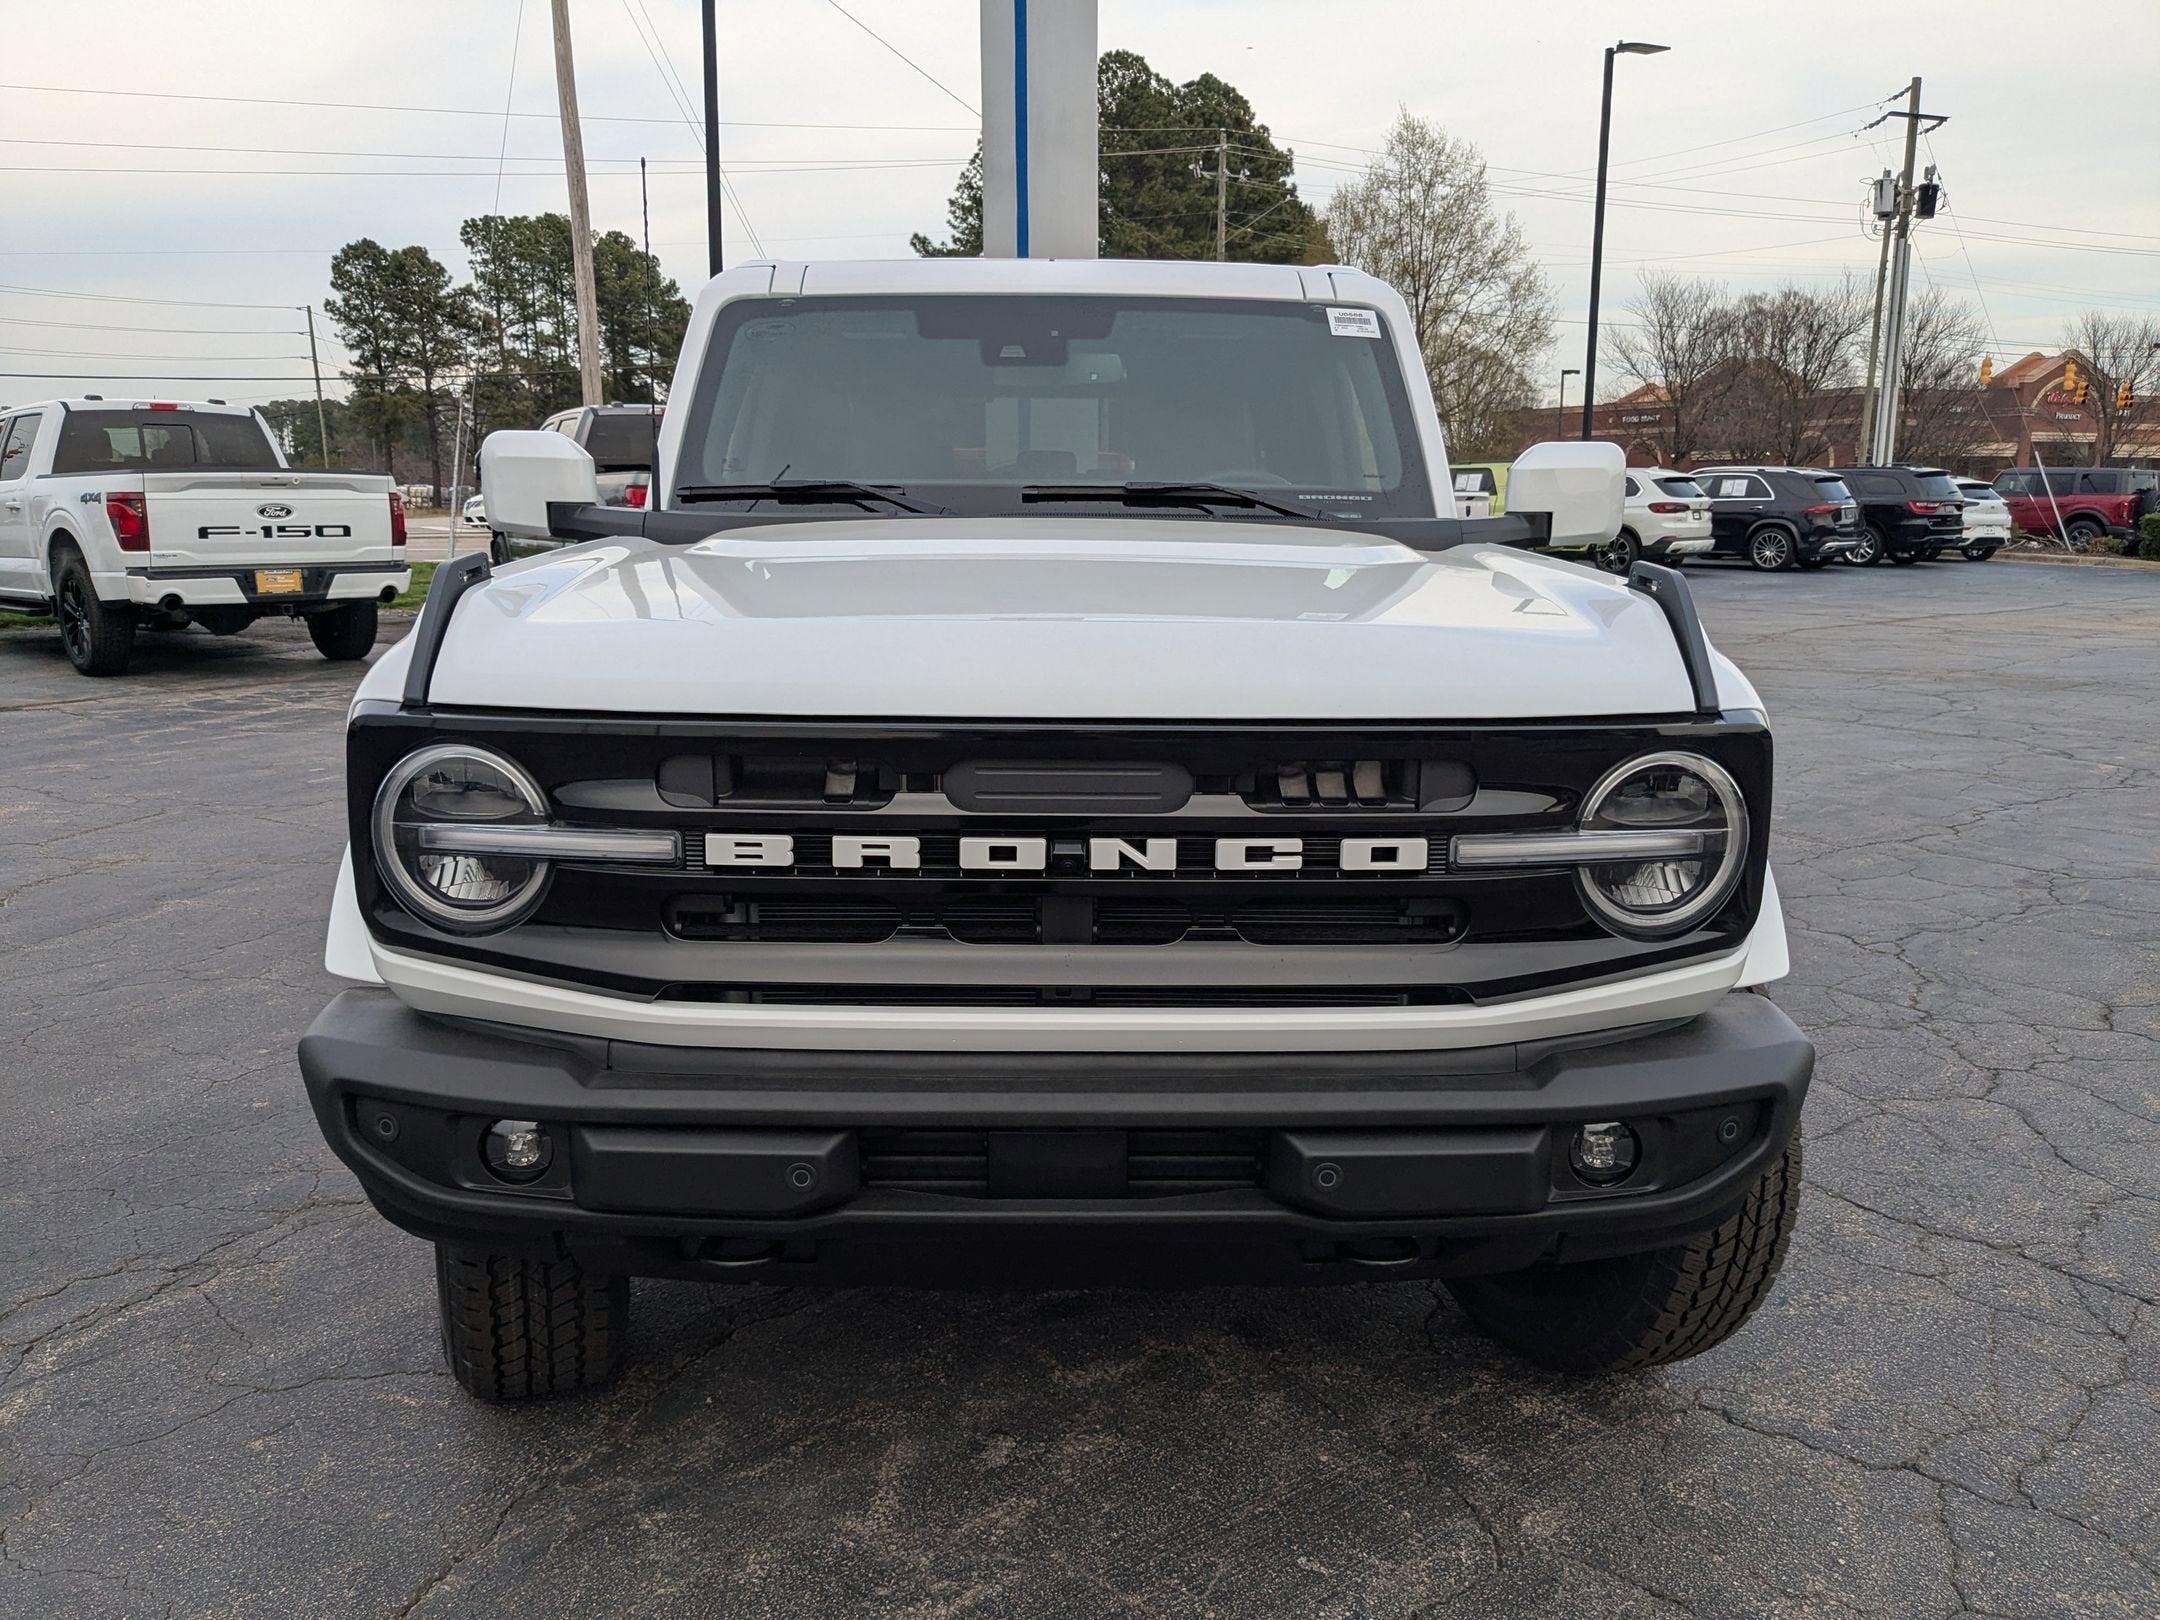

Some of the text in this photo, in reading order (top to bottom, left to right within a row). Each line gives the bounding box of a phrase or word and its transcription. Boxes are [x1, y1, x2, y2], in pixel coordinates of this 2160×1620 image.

[263, 506, 288, 518] Ford
[198, 525, 351, 539] F-150
[704, 833, 1429, 873] BRONCO
